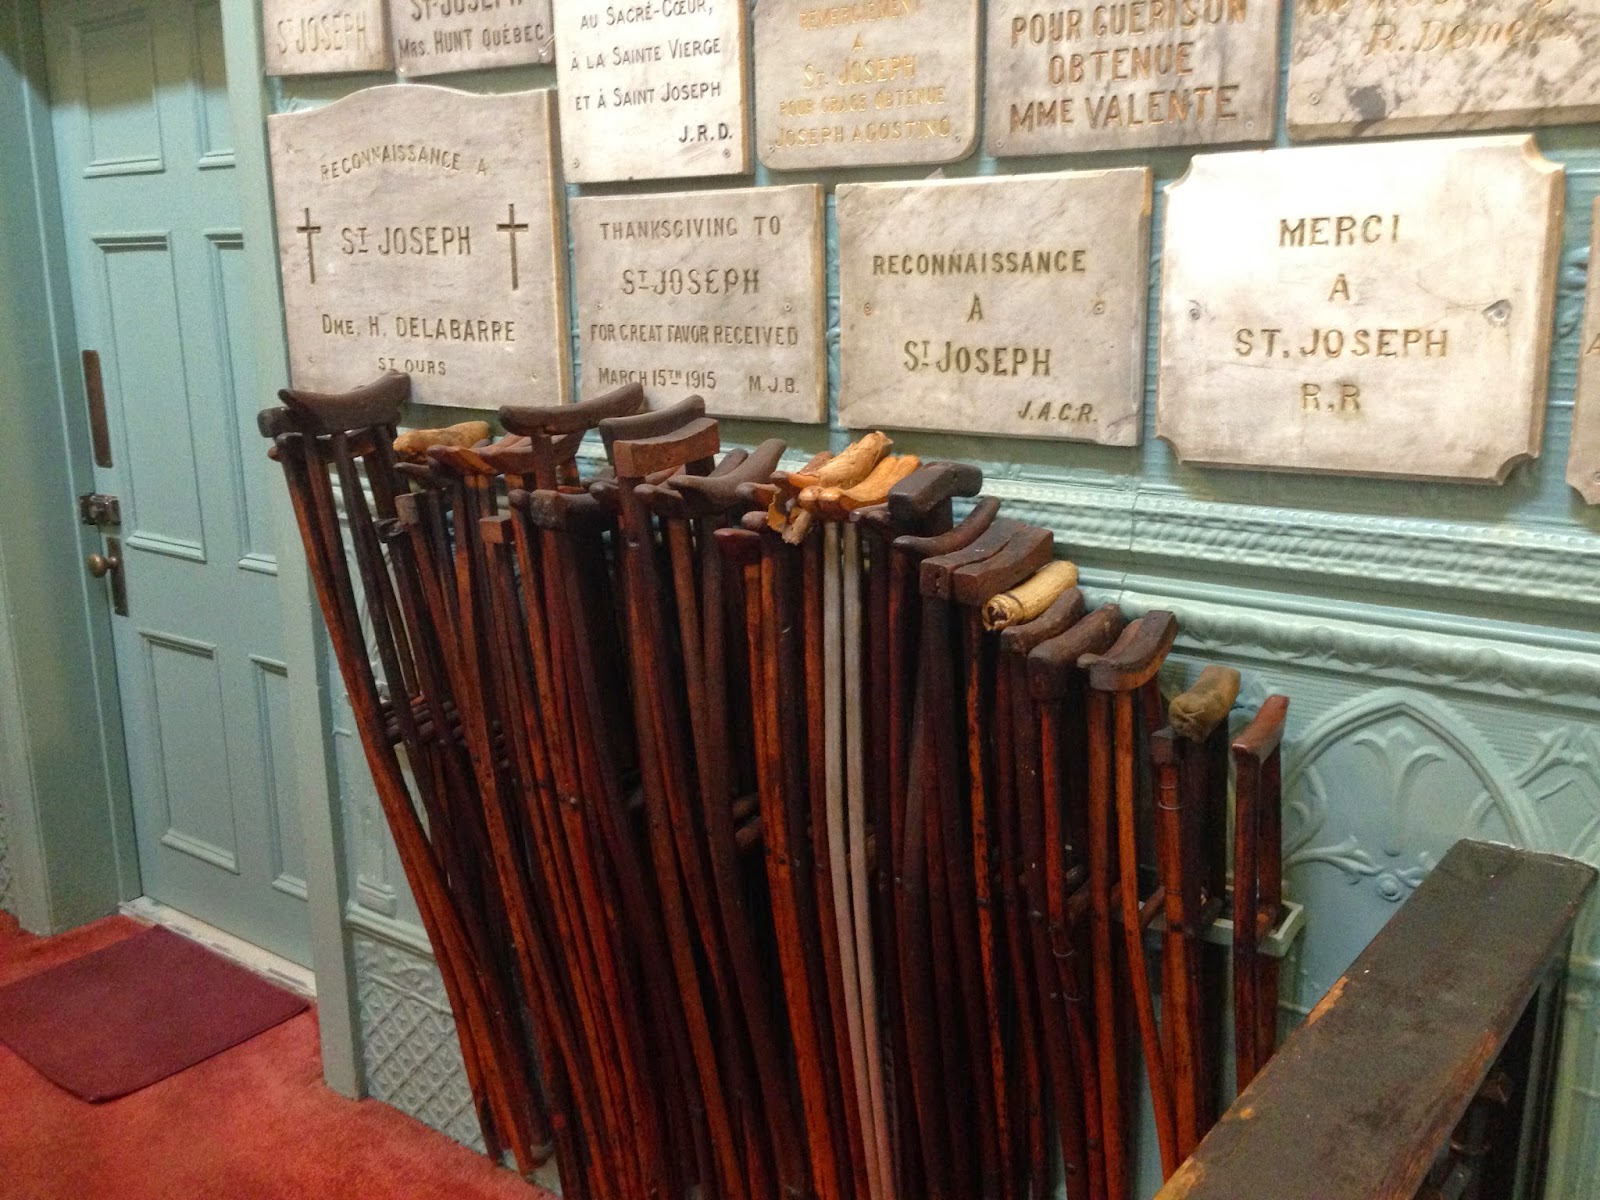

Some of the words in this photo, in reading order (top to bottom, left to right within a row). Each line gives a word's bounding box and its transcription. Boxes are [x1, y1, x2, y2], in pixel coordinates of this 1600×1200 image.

[295, 11, 367, 54] JOSEPH
[580, 14, 598, 30] AU
[1011, 9, 1082, 47] POUR
[433, 28, 472, 54] HUNT
[482, 23, 545, 51] QUÉBEC
[586, 53, 606, 70] LA
[612, 46, 662, 66] SAINTE
[668, 38, 721, 60] VIERGE
[1049, 41, 1195, 87] OBTENUE
[838, 54, 917, 86] JOSEPH
[575, 95, 590, 111] ET
[613, 87, 655, 107] SAINT
[660, 81, 721, 102] JOSEPH
[875, 86, 946, 110] OBTENUE
[1085, 84, 1240, 130] VALENTE
[775, 124, 845, 148] JOSEPH
[320, 144, 462, 182] RECONNAISSANCE
[378, 226, 472, 256] JOSEPH
[600, 216, 738, 240] THANKSGIVING
[754, 215, 781, 236] TO
[1278, 213, 1400, 248] MERCI
[872, 249, 1086, 276] RECONNAISSANCE
[652, 268, 760, 295] JOSEPH
[1328, 272, 1351, 302] A
[396, 317, 516, 342] DELABARRE
[590, 324, 615, 343] FOR
[619, 324, 663, 343] GREAT
[668, 324, 709, 344] FAVOR
[714, 325, 798, 346] RECEIVED
[1300, 328, 1449, 359] JOSEPH
[404, 359, 447, 376] OURS
[936, 341, 1051, 377] JOSEPH
[598, 367, 647, 387] MARCH
[686, 370, 717, 389] 1915
